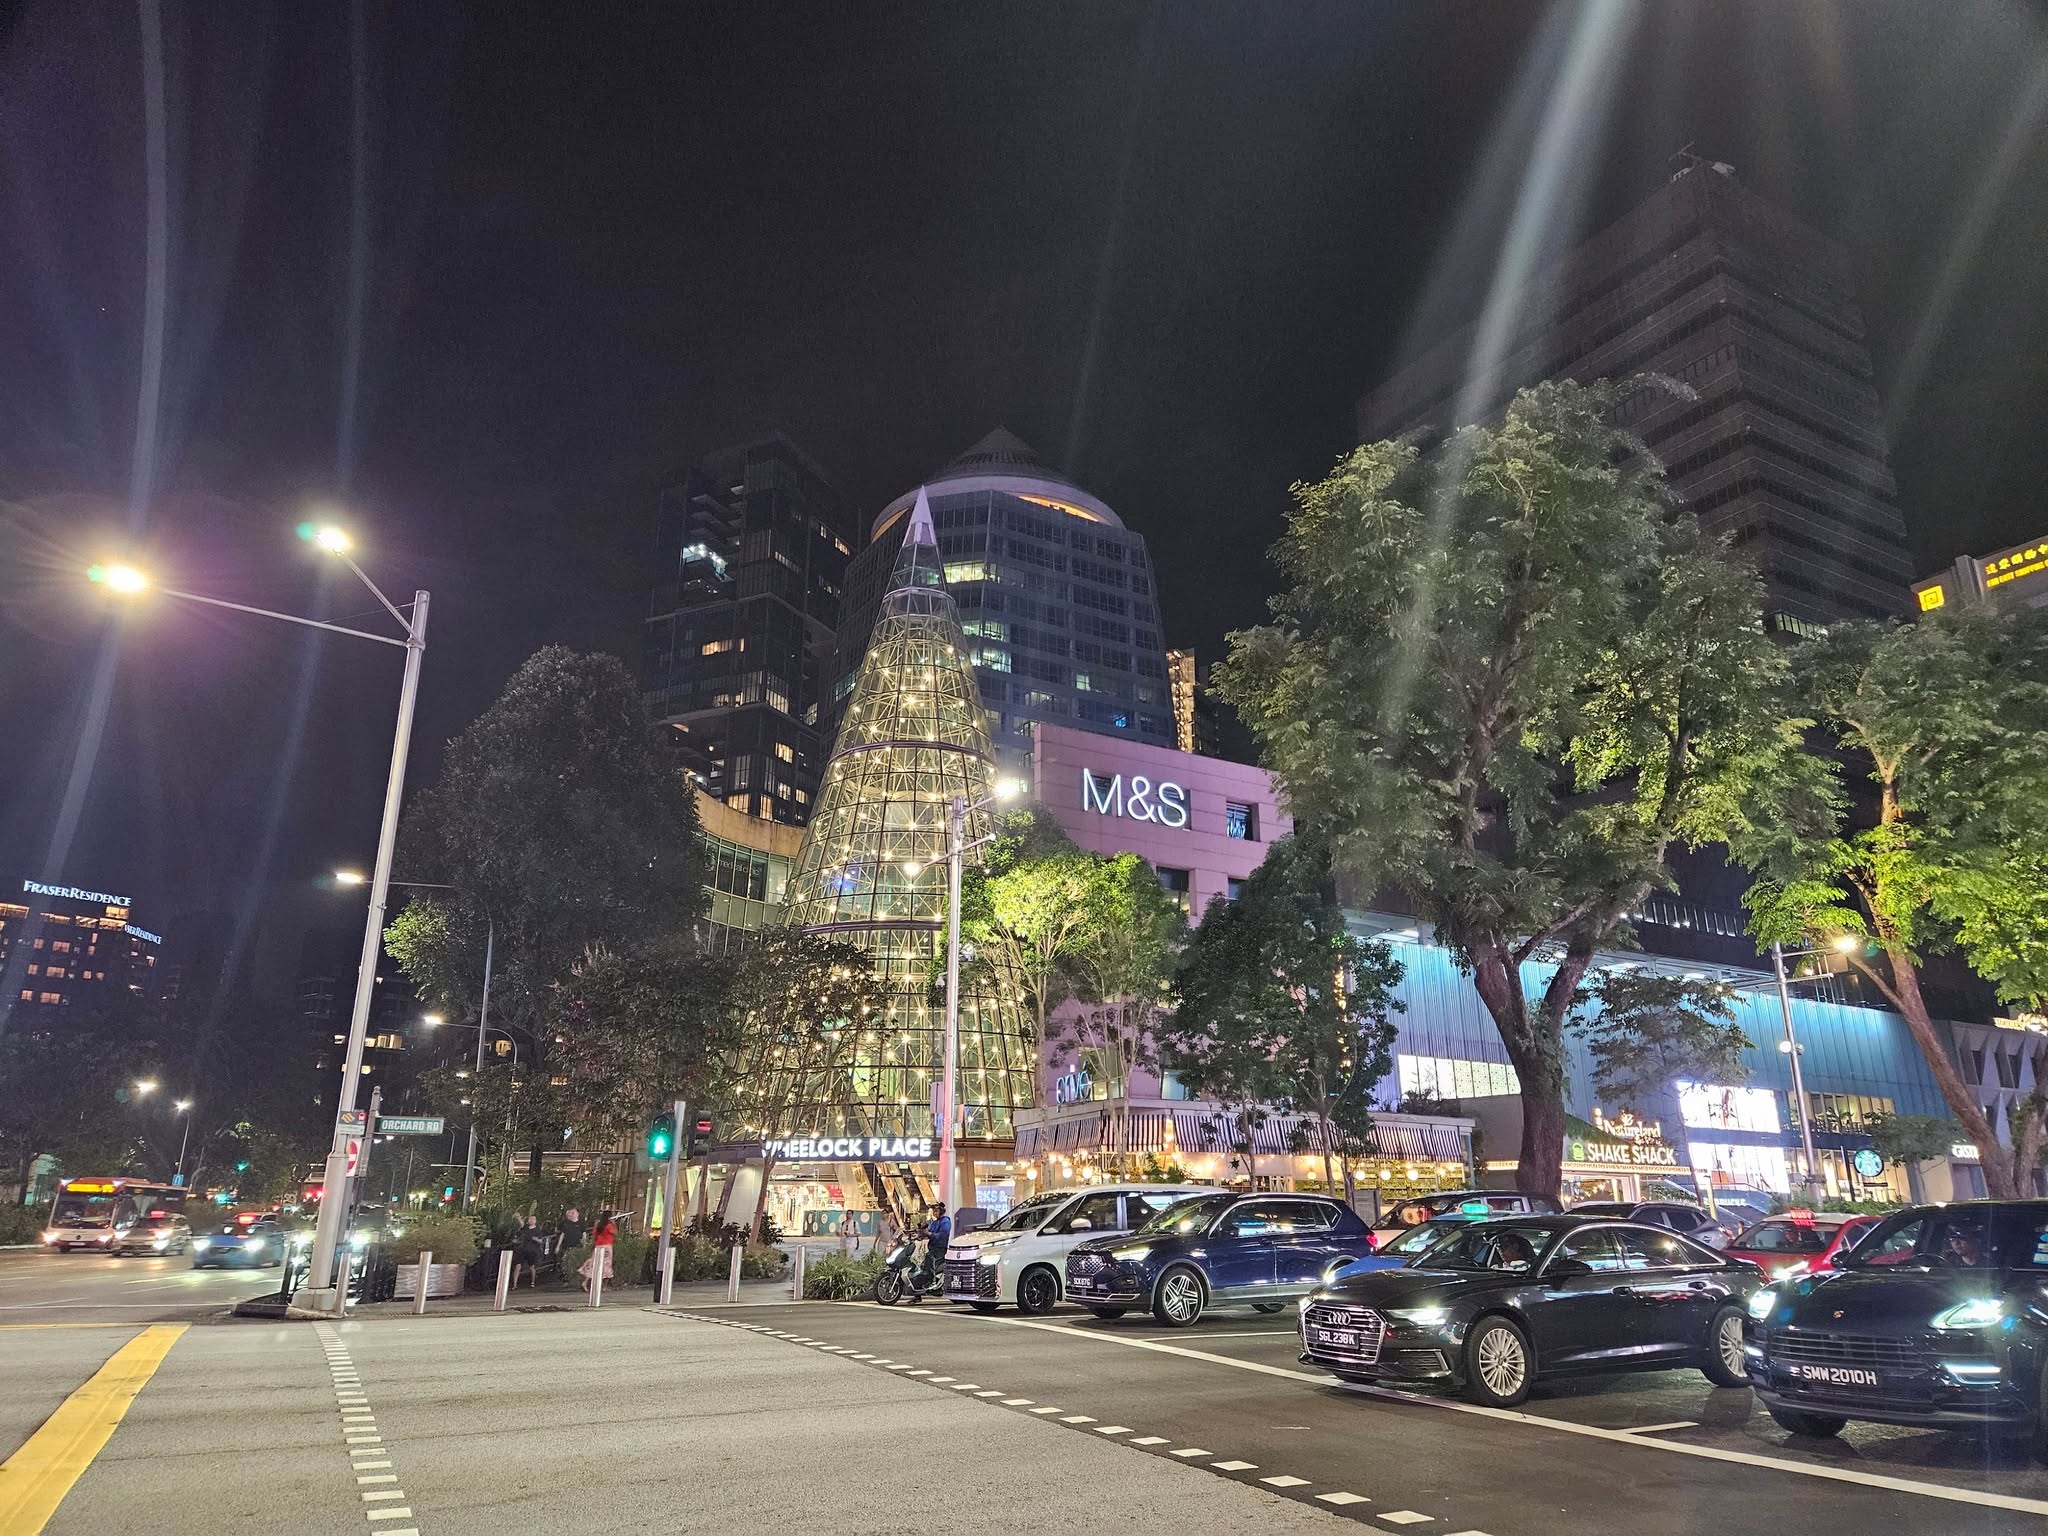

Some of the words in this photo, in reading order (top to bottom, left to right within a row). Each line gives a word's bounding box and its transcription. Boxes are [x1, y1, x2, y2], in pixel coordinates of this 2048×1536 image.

[1083, 767, 1187, 828] M&S
[381, 1119, 424, 1132] ORCHARD
[426, 1121, 440, 1132] RD
[868, 1137, 932, 1158] PLACE
[1587, 1142, 1631, 1164] SHAKE
[1631, 1145, 1677, 1166] SHACK
